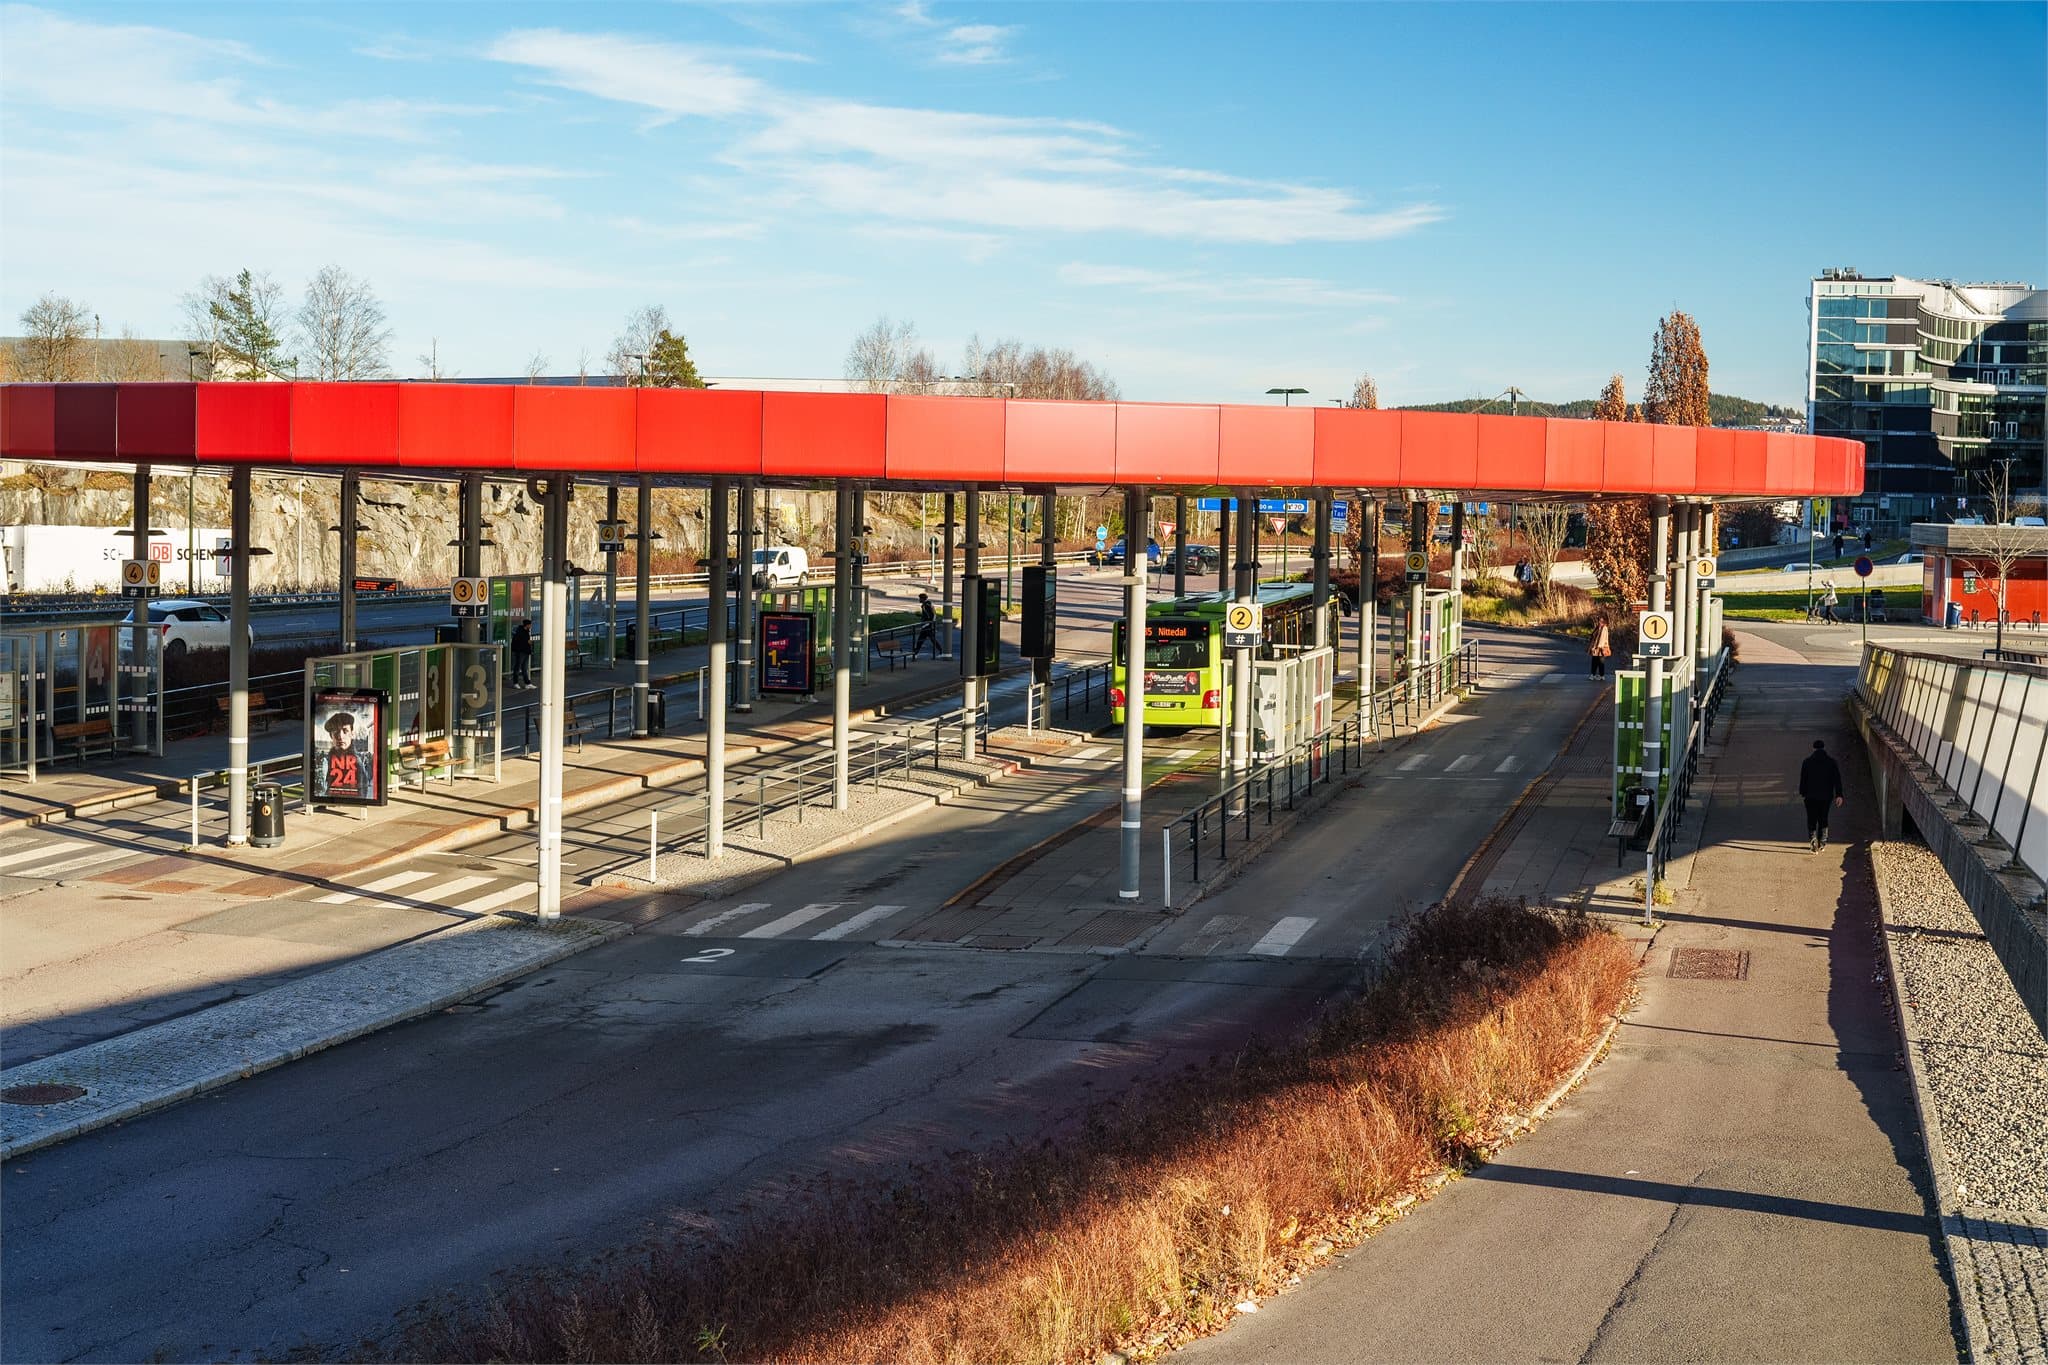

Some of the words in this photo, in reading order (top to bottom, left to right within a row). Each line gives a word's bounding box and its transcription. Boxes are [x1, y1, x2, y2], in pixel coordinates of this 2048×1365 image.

[604, 529, 610, 539] 4
[153, 546, 169, 560] DB
[176, 548, 215, 561] SCHEN
[1412, 557, 1420, 567] 2
[1701, 563, 1707, 573] 1
[130, 567, 138, 580] 4
[150, 566, 156, 580] 4
[459, 584, 467, 598] 3
[479, 584, 485, 598] 3
[1236, 611, 1246, 625] 2
[1158, 627, 1187, 636] Nittedal
[1650, 619, 1657, 635] 1
[88, 646, 104, 686] 4
[428, 665, 440, 709] 3
[465, 664, 489, 709] 3
[331, 755, 357, 770] NR
[330, 769, 357, 787] 24
[680, 948, 736, 963] 2
